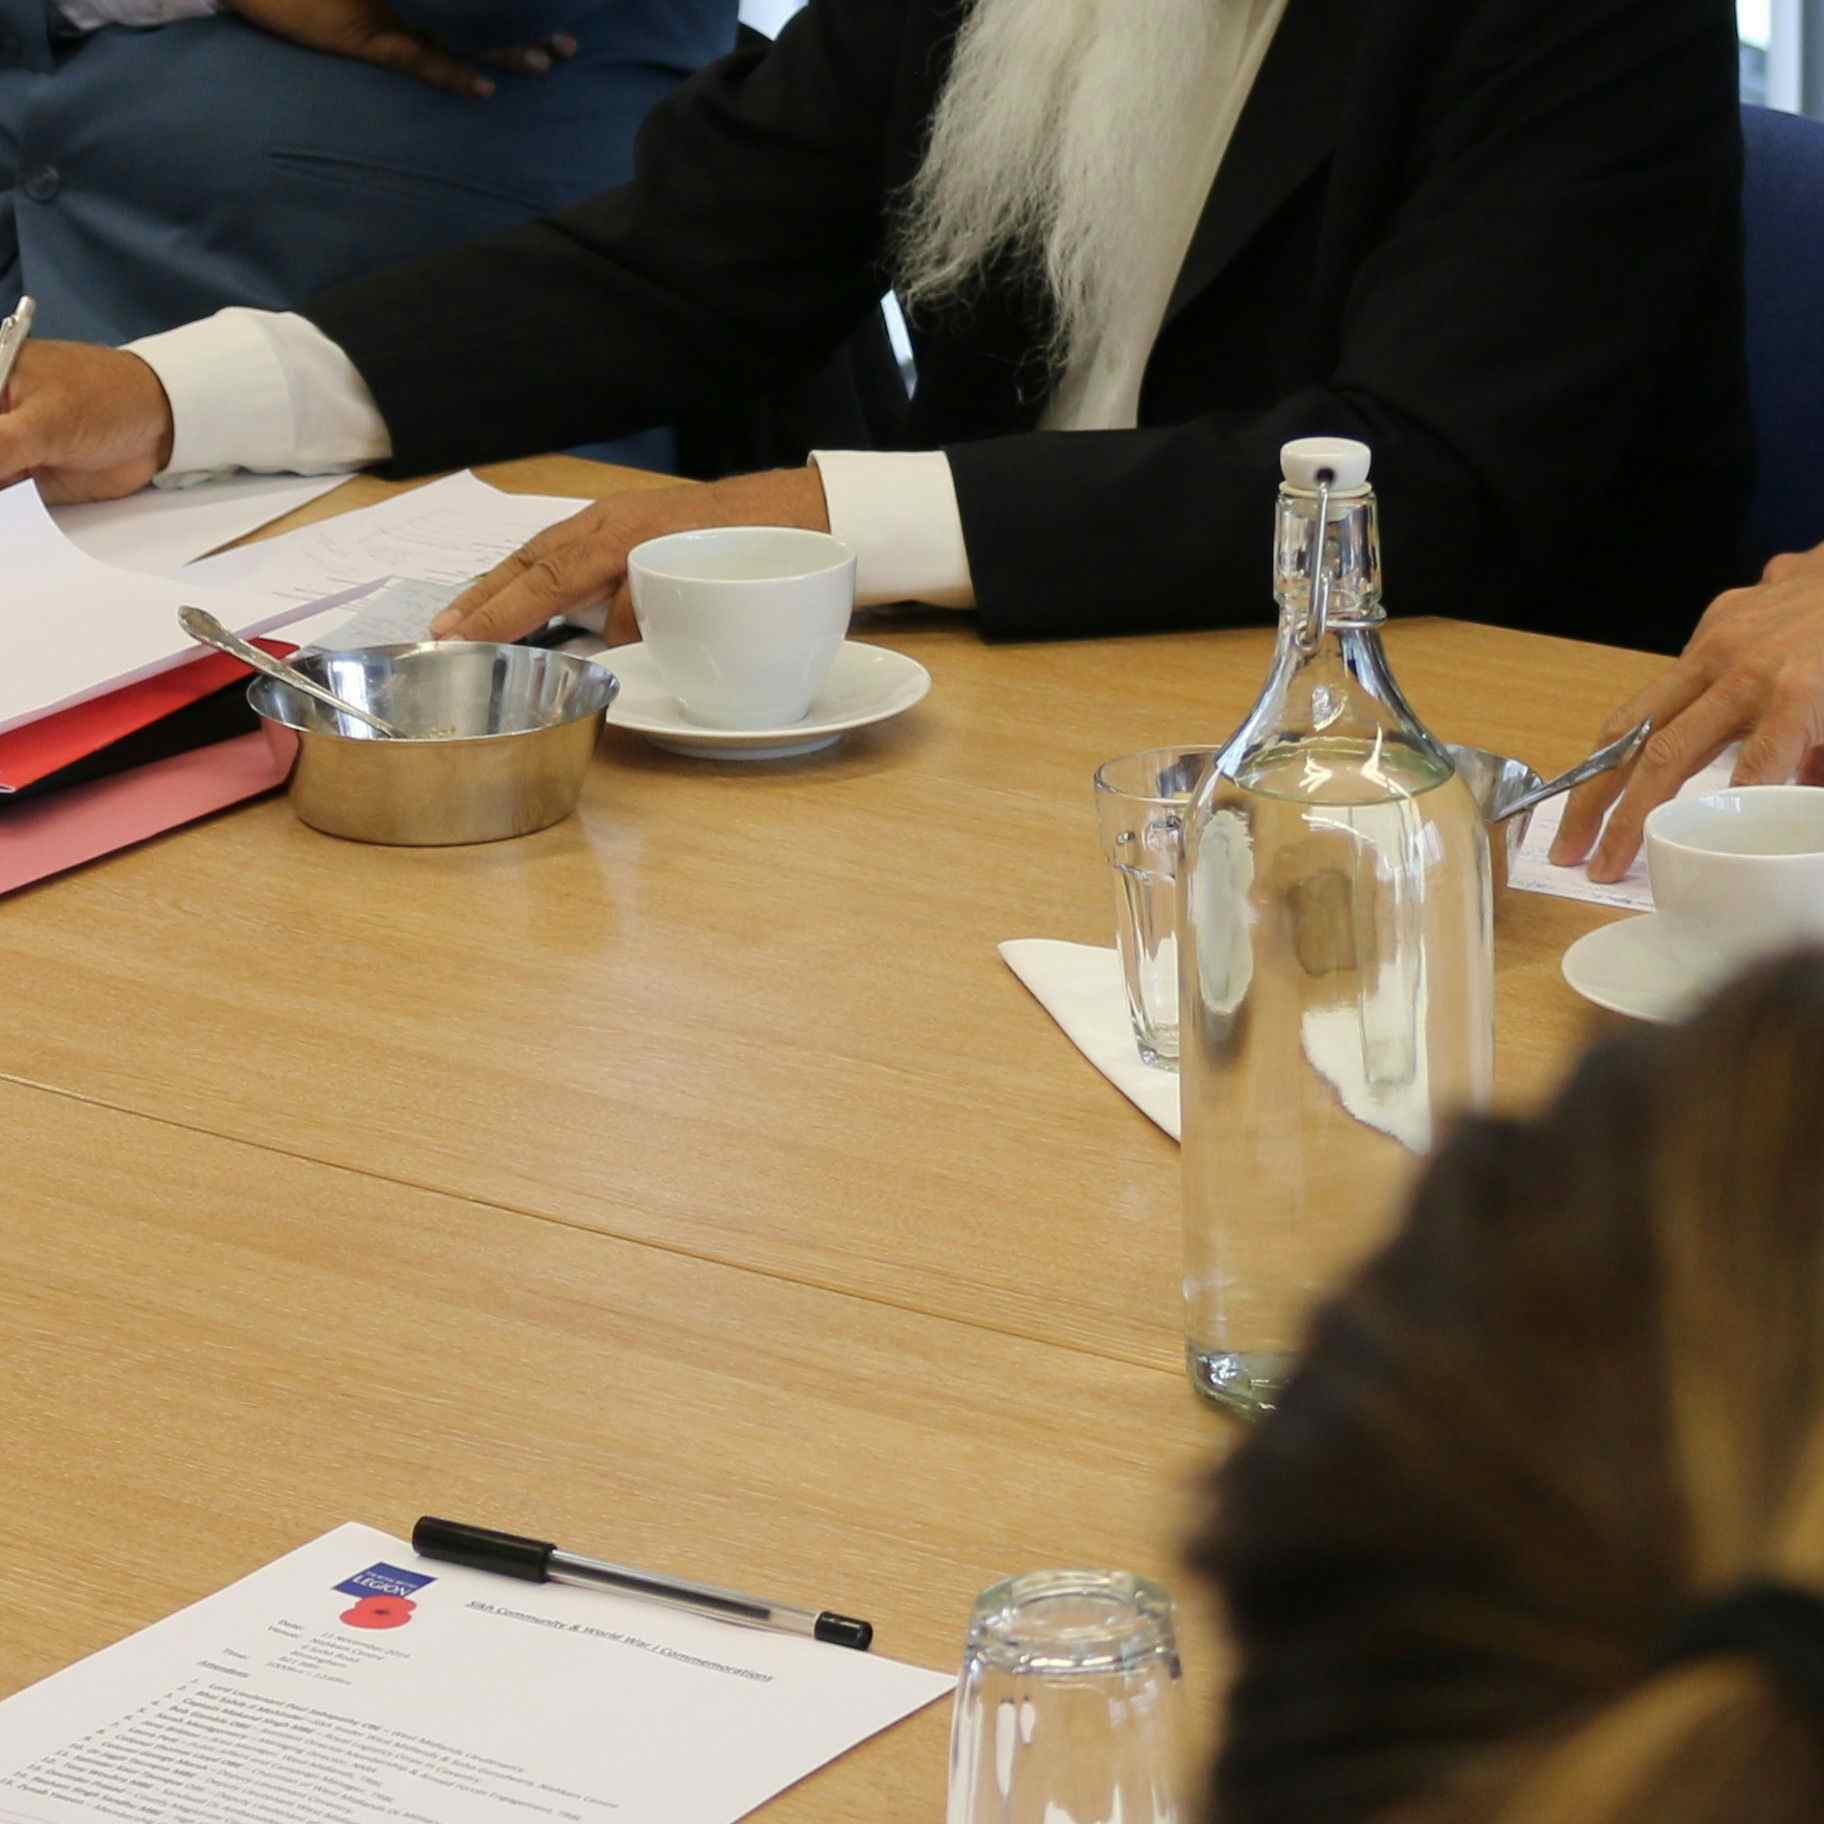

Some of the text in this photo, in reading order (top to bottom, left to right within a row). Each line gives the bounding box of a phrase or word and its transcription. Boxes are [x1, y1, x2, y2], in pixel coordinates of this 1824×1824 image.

[352, 1574, 412, 1596] LEGION
[497, 1606, 566, 1630] Community
[584, 1626, 625, 1642] World
[625, 1635, 652, 1651] War
[661, 1648, 774, 1683] Commemorations
